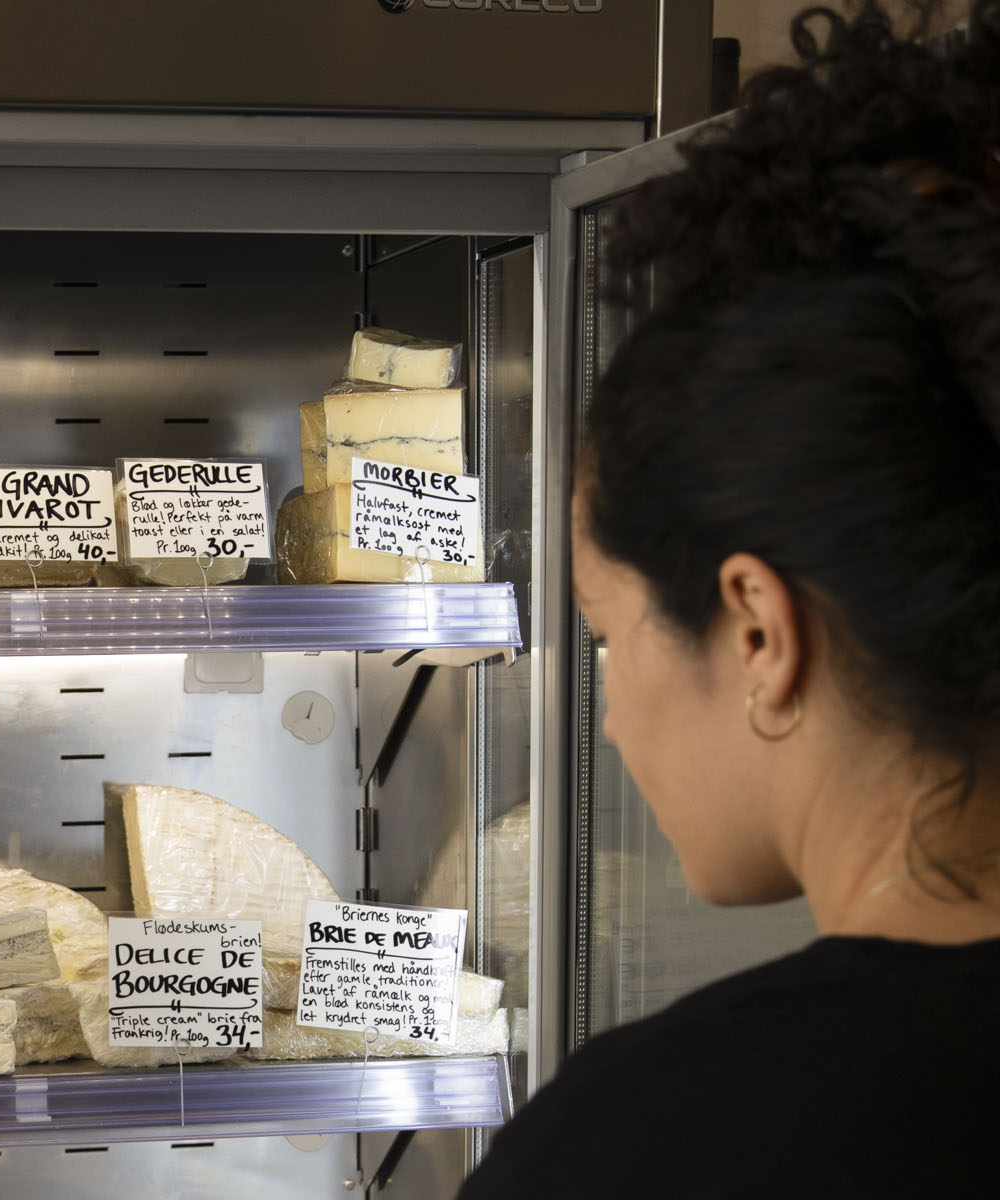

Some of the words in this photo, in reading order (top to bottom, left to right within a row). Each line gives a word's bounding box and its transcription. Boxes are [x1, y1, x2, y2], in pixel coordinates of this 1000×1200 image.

[129, 464, 252, 488] GEDERULLE
[363, 462, 459, 495] MORBIER
[2, 471, 89, 500] GRAND
[132, 500, 156, 512] Blød
[218, 497, 249, 511] gede-
[357, 493, 413, 517] Halvfast,
[418, 506, 461, 521] cremet
[133, 512, 166, 525] rulle!
[168, 511, 211, 523] Perfekt
[236, 512, 264, 520] varm
[355, 509, 431, 529] råmælksost
[438, 525, 463, 536] med
[70, 529, 109, 541] delikat
[132, 526, 163, 537] toast
[233, 524, 264, 537] salat!
[207, 538, 254, 557] 30,-
[431, 537, 465, 551] aske!
[78, 543, 116, 564] 40,-
[443, 550, 475, 566] 30,-
[143, 920, 236, 935] Flødeskums-
[309, 922, 357, 943] BRIE
[365, 932, 386, 946] DE
[393, 932, 458, 949] MEAUX
[221, 933, 262, 948] brien!
[115, 943, 205, 966] DELICE
[221, 950, 255, 968] DE
[306, 956, 366, 972] Fremstilles
[112, 970, 259, 998] BOURGOGNE
[304, 972, 330, 982] efter
[337, 975, 370, 988] gamle
[303, 984, 335, 996] Lavet
[365, 985, 412, 1001] råmælk
[325, 996, 349, 1008] blød
[356, 999, 414, 1013] konsistens
[208, 1013, 235, 1024] brie
[326, 1014, 367, 1026] krydret
[374, 1016, 406, 1031] smag!
[112, 1025, 168, 1042] Frankrig!
[216, 1024, 259, 1051] 34,-
